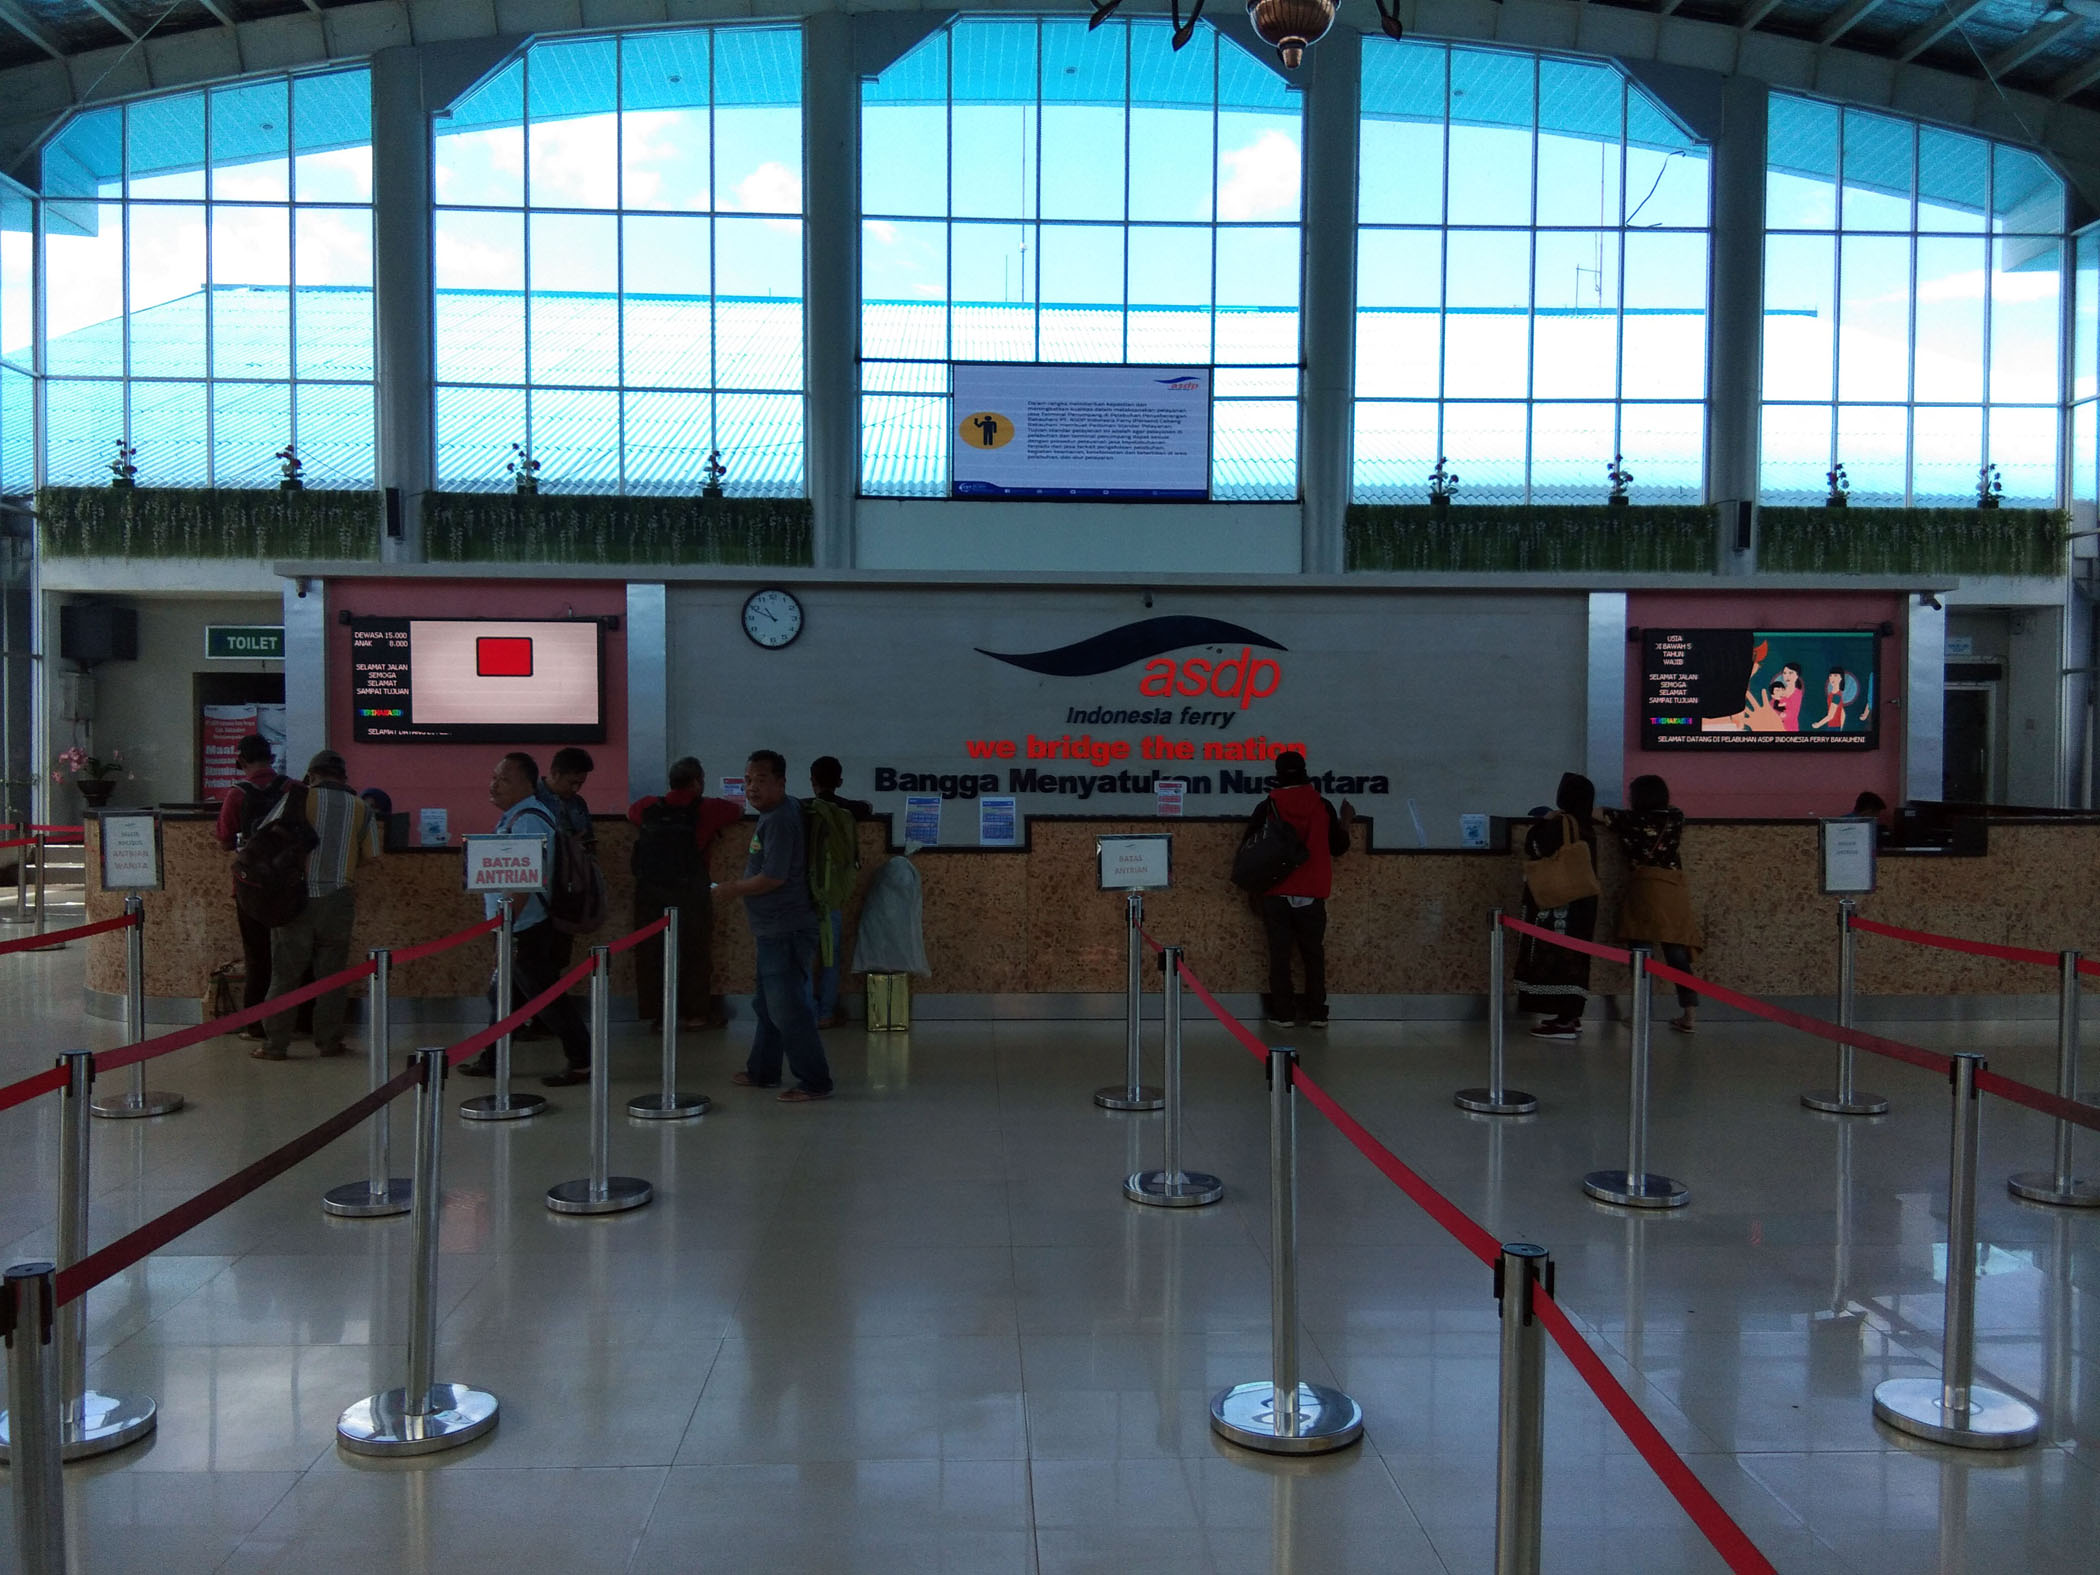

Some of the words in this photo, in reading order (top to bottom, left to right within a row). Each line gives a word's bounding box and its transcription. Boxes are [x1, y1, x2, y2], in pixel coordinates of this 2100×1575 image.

[227, 636, 278, 650] TOILET
[1139, 647, 1282, 709] asdp
[1066, 707, 1172, 726] Indonesia
[1179, 707, 1234, 729] ferry
[1658, 735, 1686, 743] SELAMAT
[966, 740, 1016, 760] we
[1027, 735, 1130, 766] bridge
[1141, 735, 1194, 760] the
[874, 768, 998, 800] Bangga
[1220, 769, 1389, 795] Nusntara
[482, 857, 531, 867] BATAS
[1119, 855, 1143, 863] BATAS
[476, 869, 538, 884] ANTRIAN
